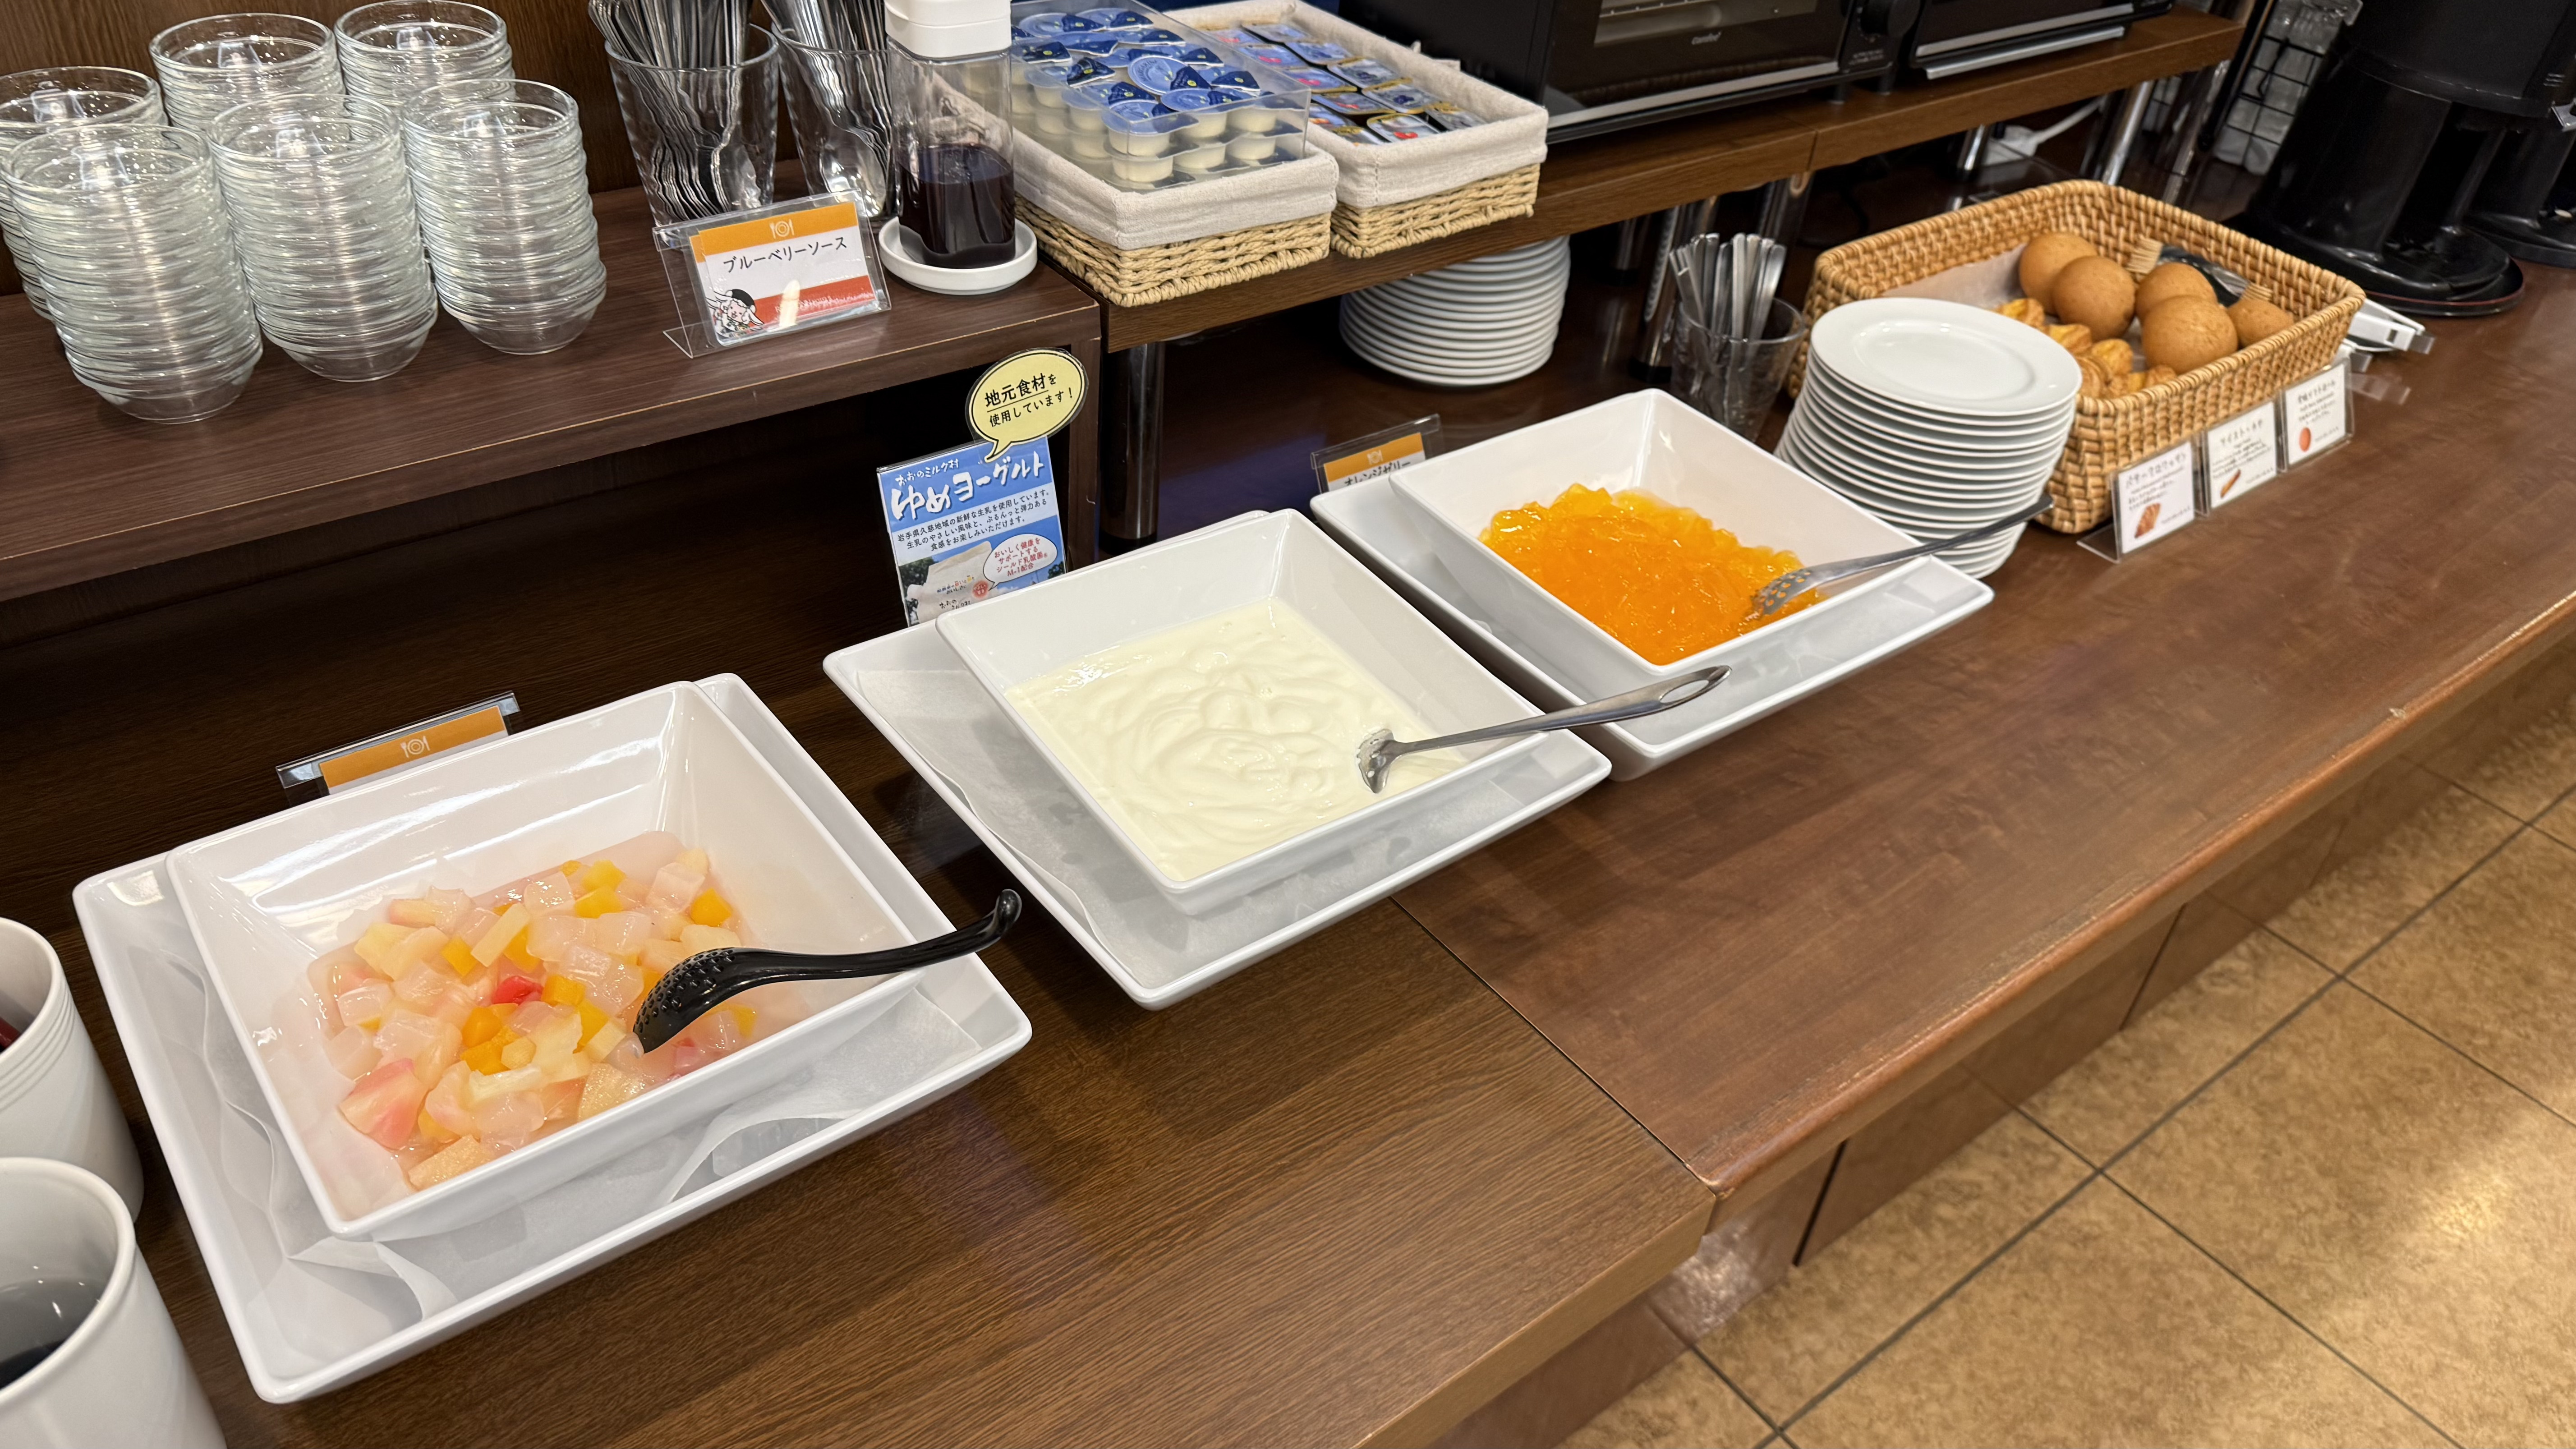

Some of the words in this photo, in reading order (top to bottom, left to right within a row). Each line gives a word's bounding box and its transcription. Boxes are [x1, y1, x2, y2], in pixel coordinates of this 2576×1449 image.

[723, 237, 847, 273] ブルーベリーソース
[984, 373, 1056, 407] 地元食材を
[989, 387, 1072, 427] 使用しています！
[891, 451, 1044, 520] ゆめヨーグルト
[895, 459, 959, 486] おおのミルク村
[897, 489, 1049, 542] 岩手県久慈地域の新鮮な生乳を使用しています。
[930, 515, 1025, 551] 食感をお楽しみいただけます。
[994, 538, 1040, 558] おいしく健康を
[998, 546, 1038, 564] サポートする
